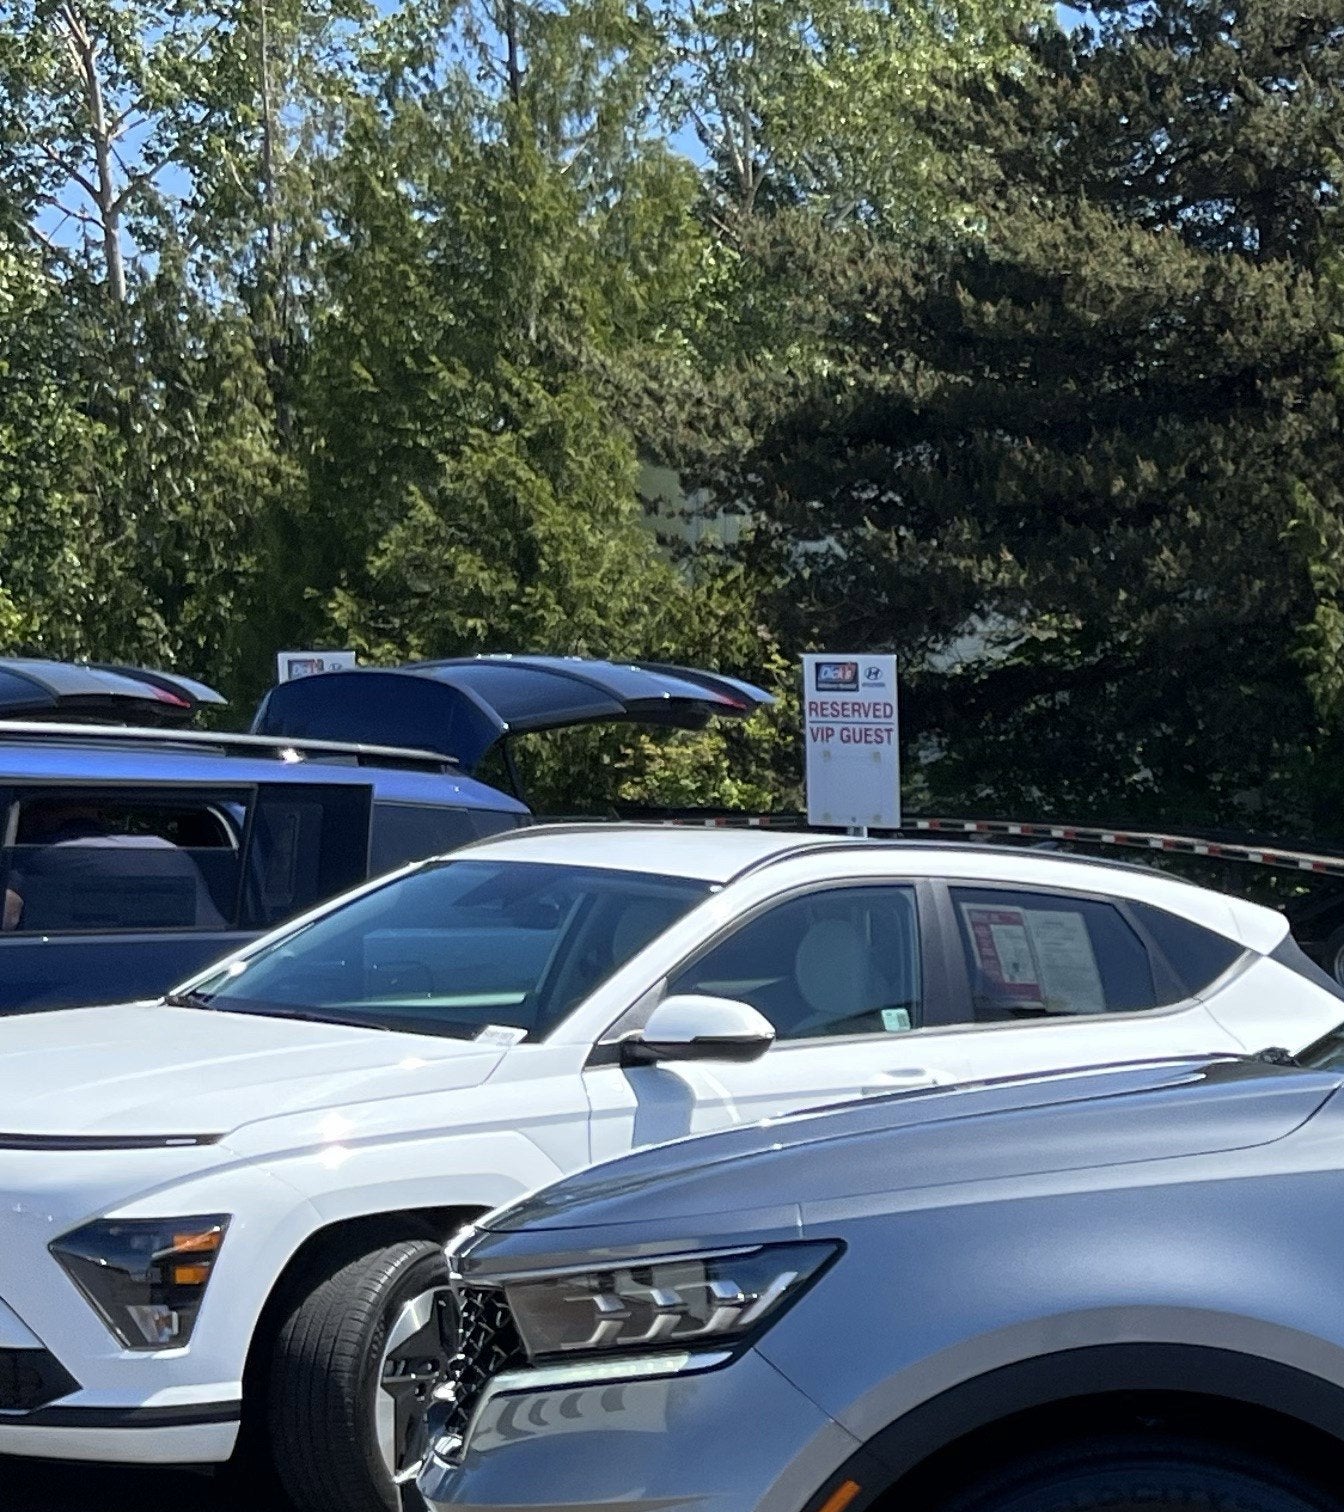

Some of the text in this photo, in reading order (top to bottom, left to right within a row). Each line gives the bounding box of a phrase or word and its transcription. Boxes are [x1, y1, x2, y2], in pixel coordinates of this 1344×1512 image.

[808, 701, 894, 719] RESERVED
[809, 726, 894, 745] VIP GUEST
